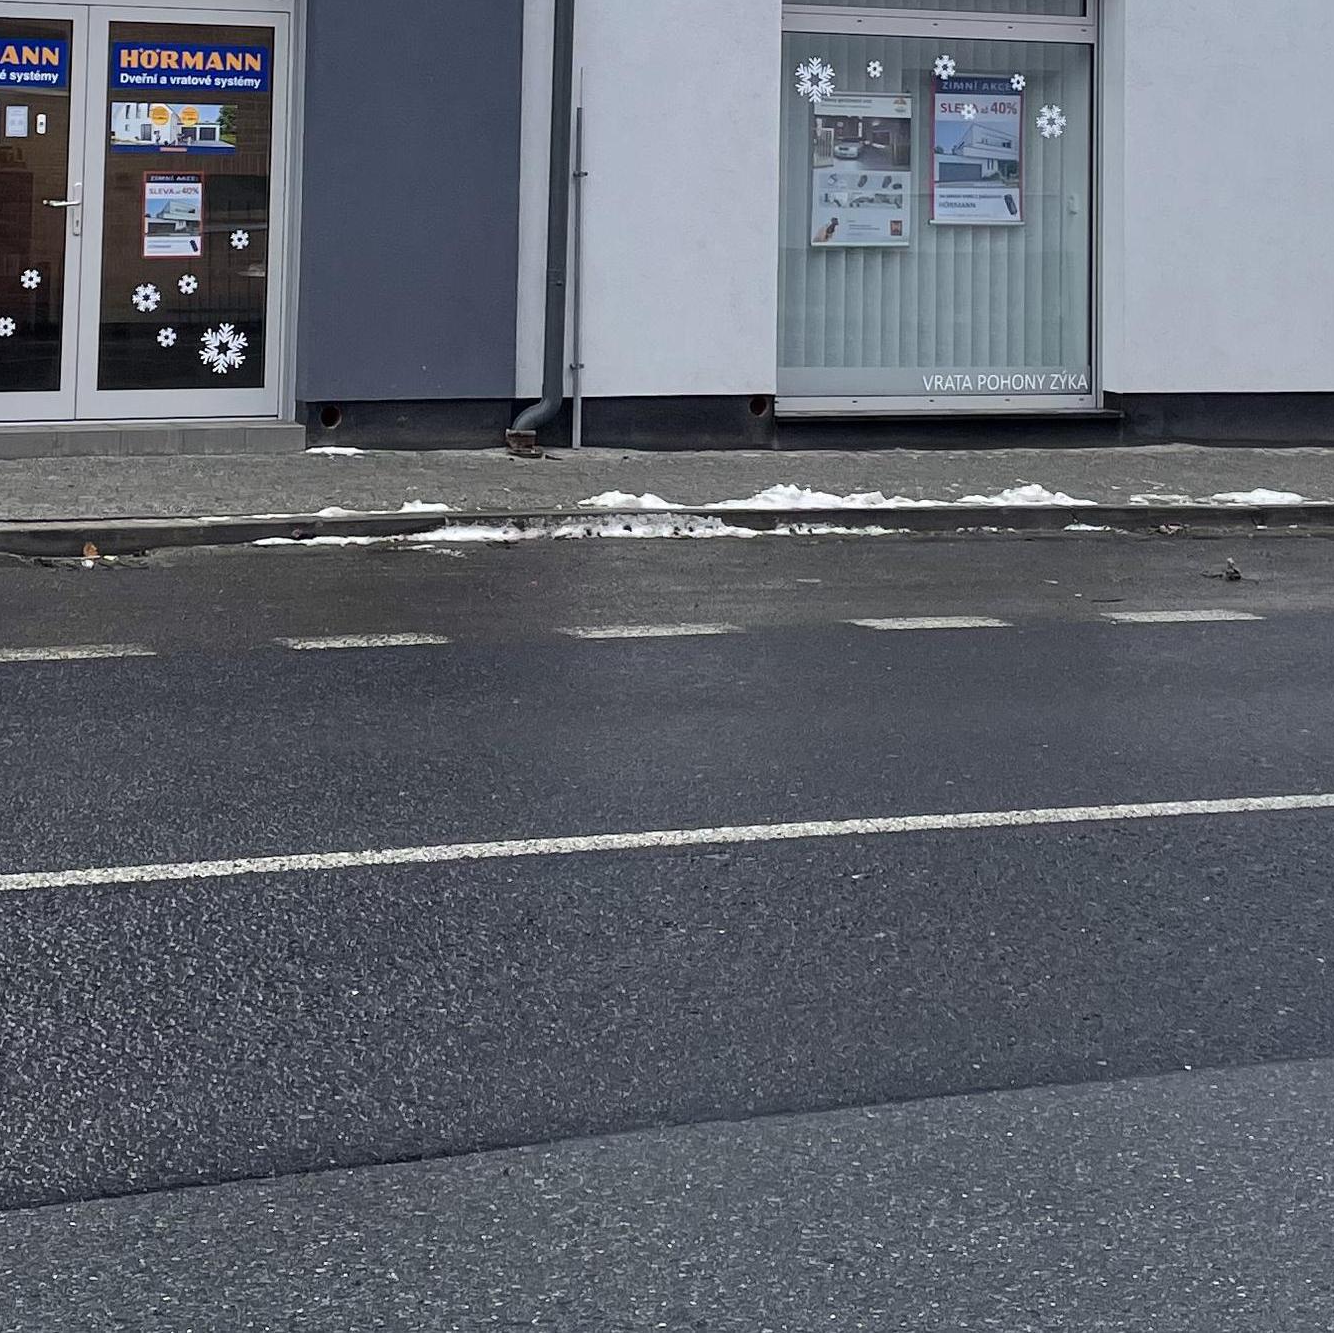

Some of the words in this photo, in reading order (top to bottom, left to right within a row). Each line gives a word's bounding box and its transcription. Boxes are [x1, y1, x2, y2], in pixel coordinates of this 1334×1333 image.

[120, 48, 261, 71] HÖRMANN
[9, 69, 59, 84] systémy
[120, 72, 158, 84] Dveřní
[160, 75, 167, 84] a
[170, 74, 212, 86] vratové
[214, 75, 261, 89] systémy
[990, 102, 1018, 115] 40%
[922, 374, 973, 390] VRATA
[977, 374, 1046, 390] POHONY
[1050, 370, 1088, 390] ZÝKA
